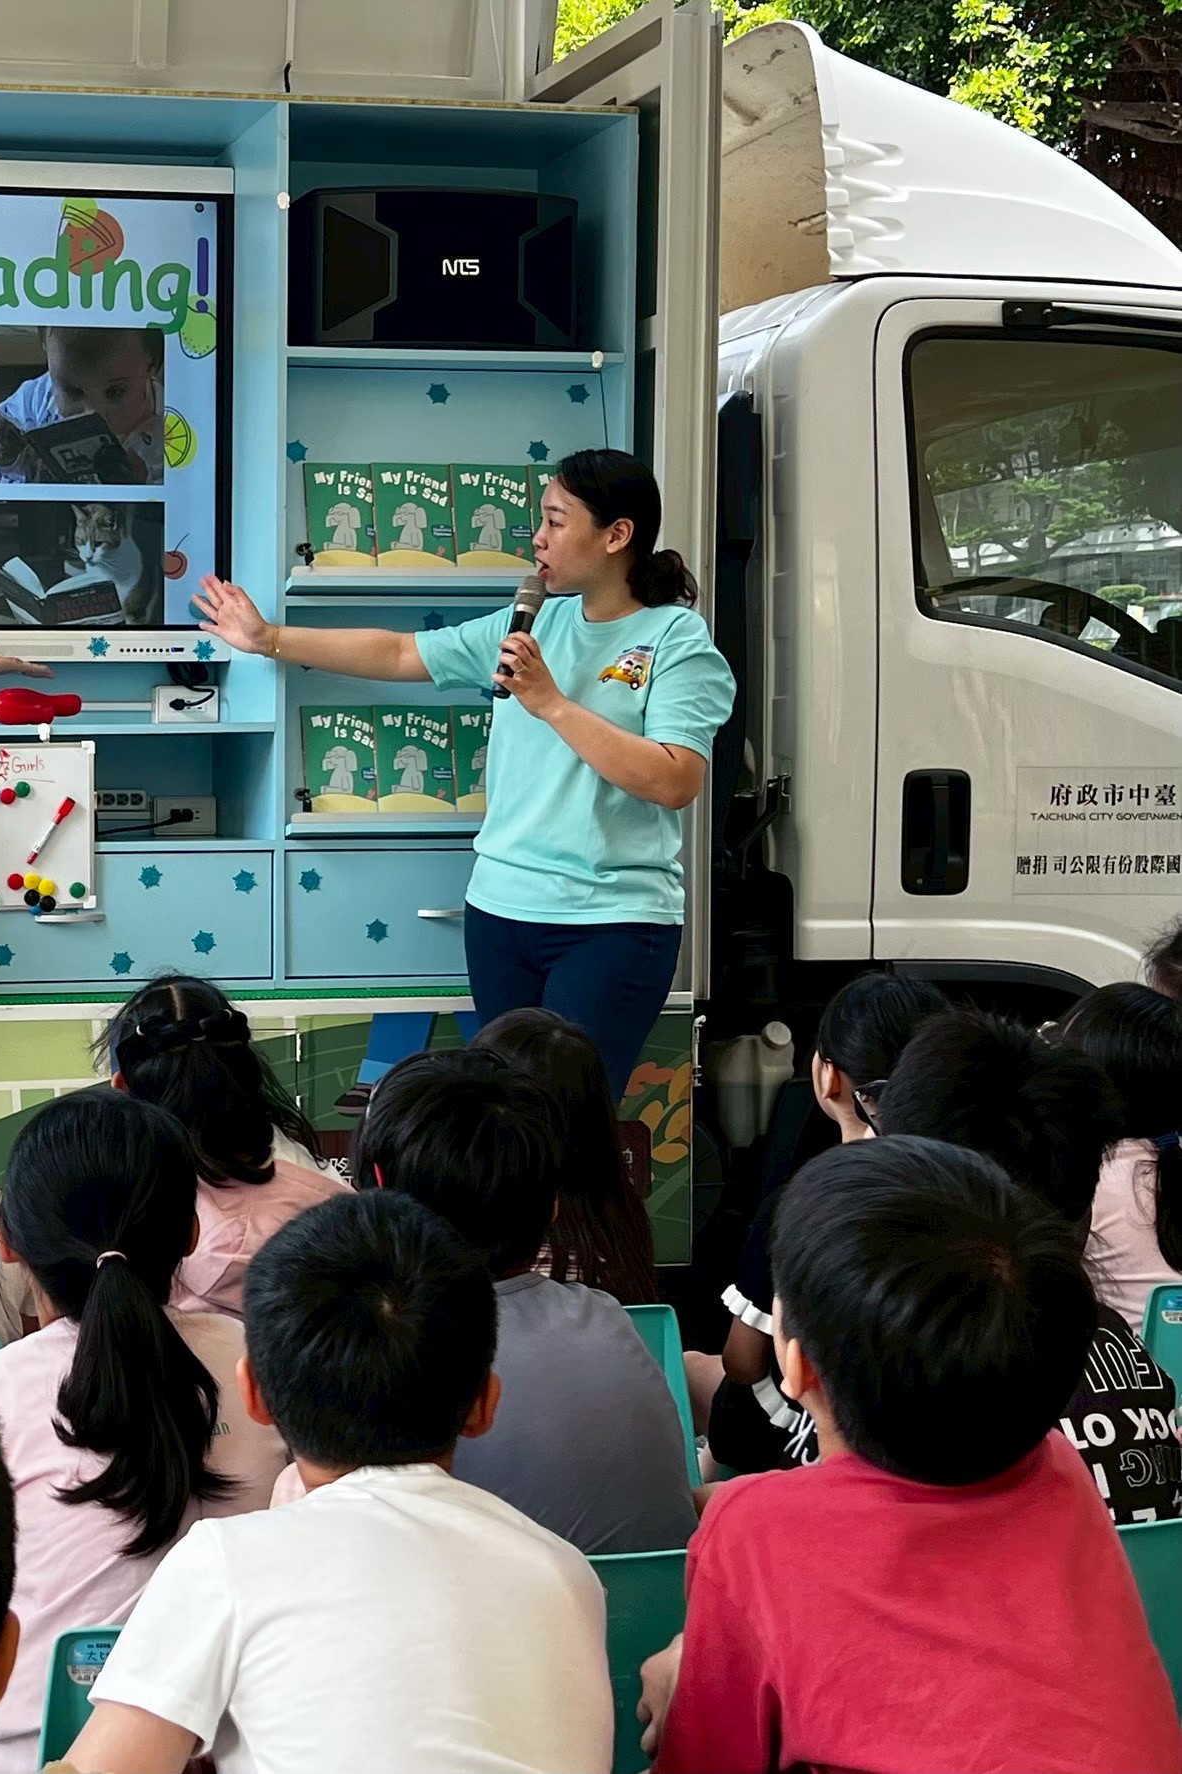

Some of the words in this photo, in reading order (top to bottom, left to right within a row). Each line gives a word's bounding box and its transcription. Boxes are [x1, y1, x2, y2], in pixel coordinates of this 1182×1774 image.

[442, 258, 480, 276] NTS
[314, 471, 335, 485] My
[381, 471, 401, 485] My
[406, 470, 448, 493] Friend
[459, 472, 480, 486] My
[484, 471, 526, 494] Friend
[338, 483, 351, 495] Is
[404, 483, 417, 495] Is
[422, 487, 448, 507] Sad
[482, 484, 496, 497] Is
[500, 488, 527, 508] Sad
[310, 714, 332, 729] My
[336, 713, 374, 734] Frien
[382, 713, 402, 728] My
[406, 712, 448, 735] Friend
[460, 713, 481, 727] My
[334, 726, 347, 738] Is
[405, 726, 418, 738] Is
[422, 729, 449, 749] Sad
[1030, 812, 1086, 821] TAICHUNG
[1089, 812, 1114, 821] CITY
